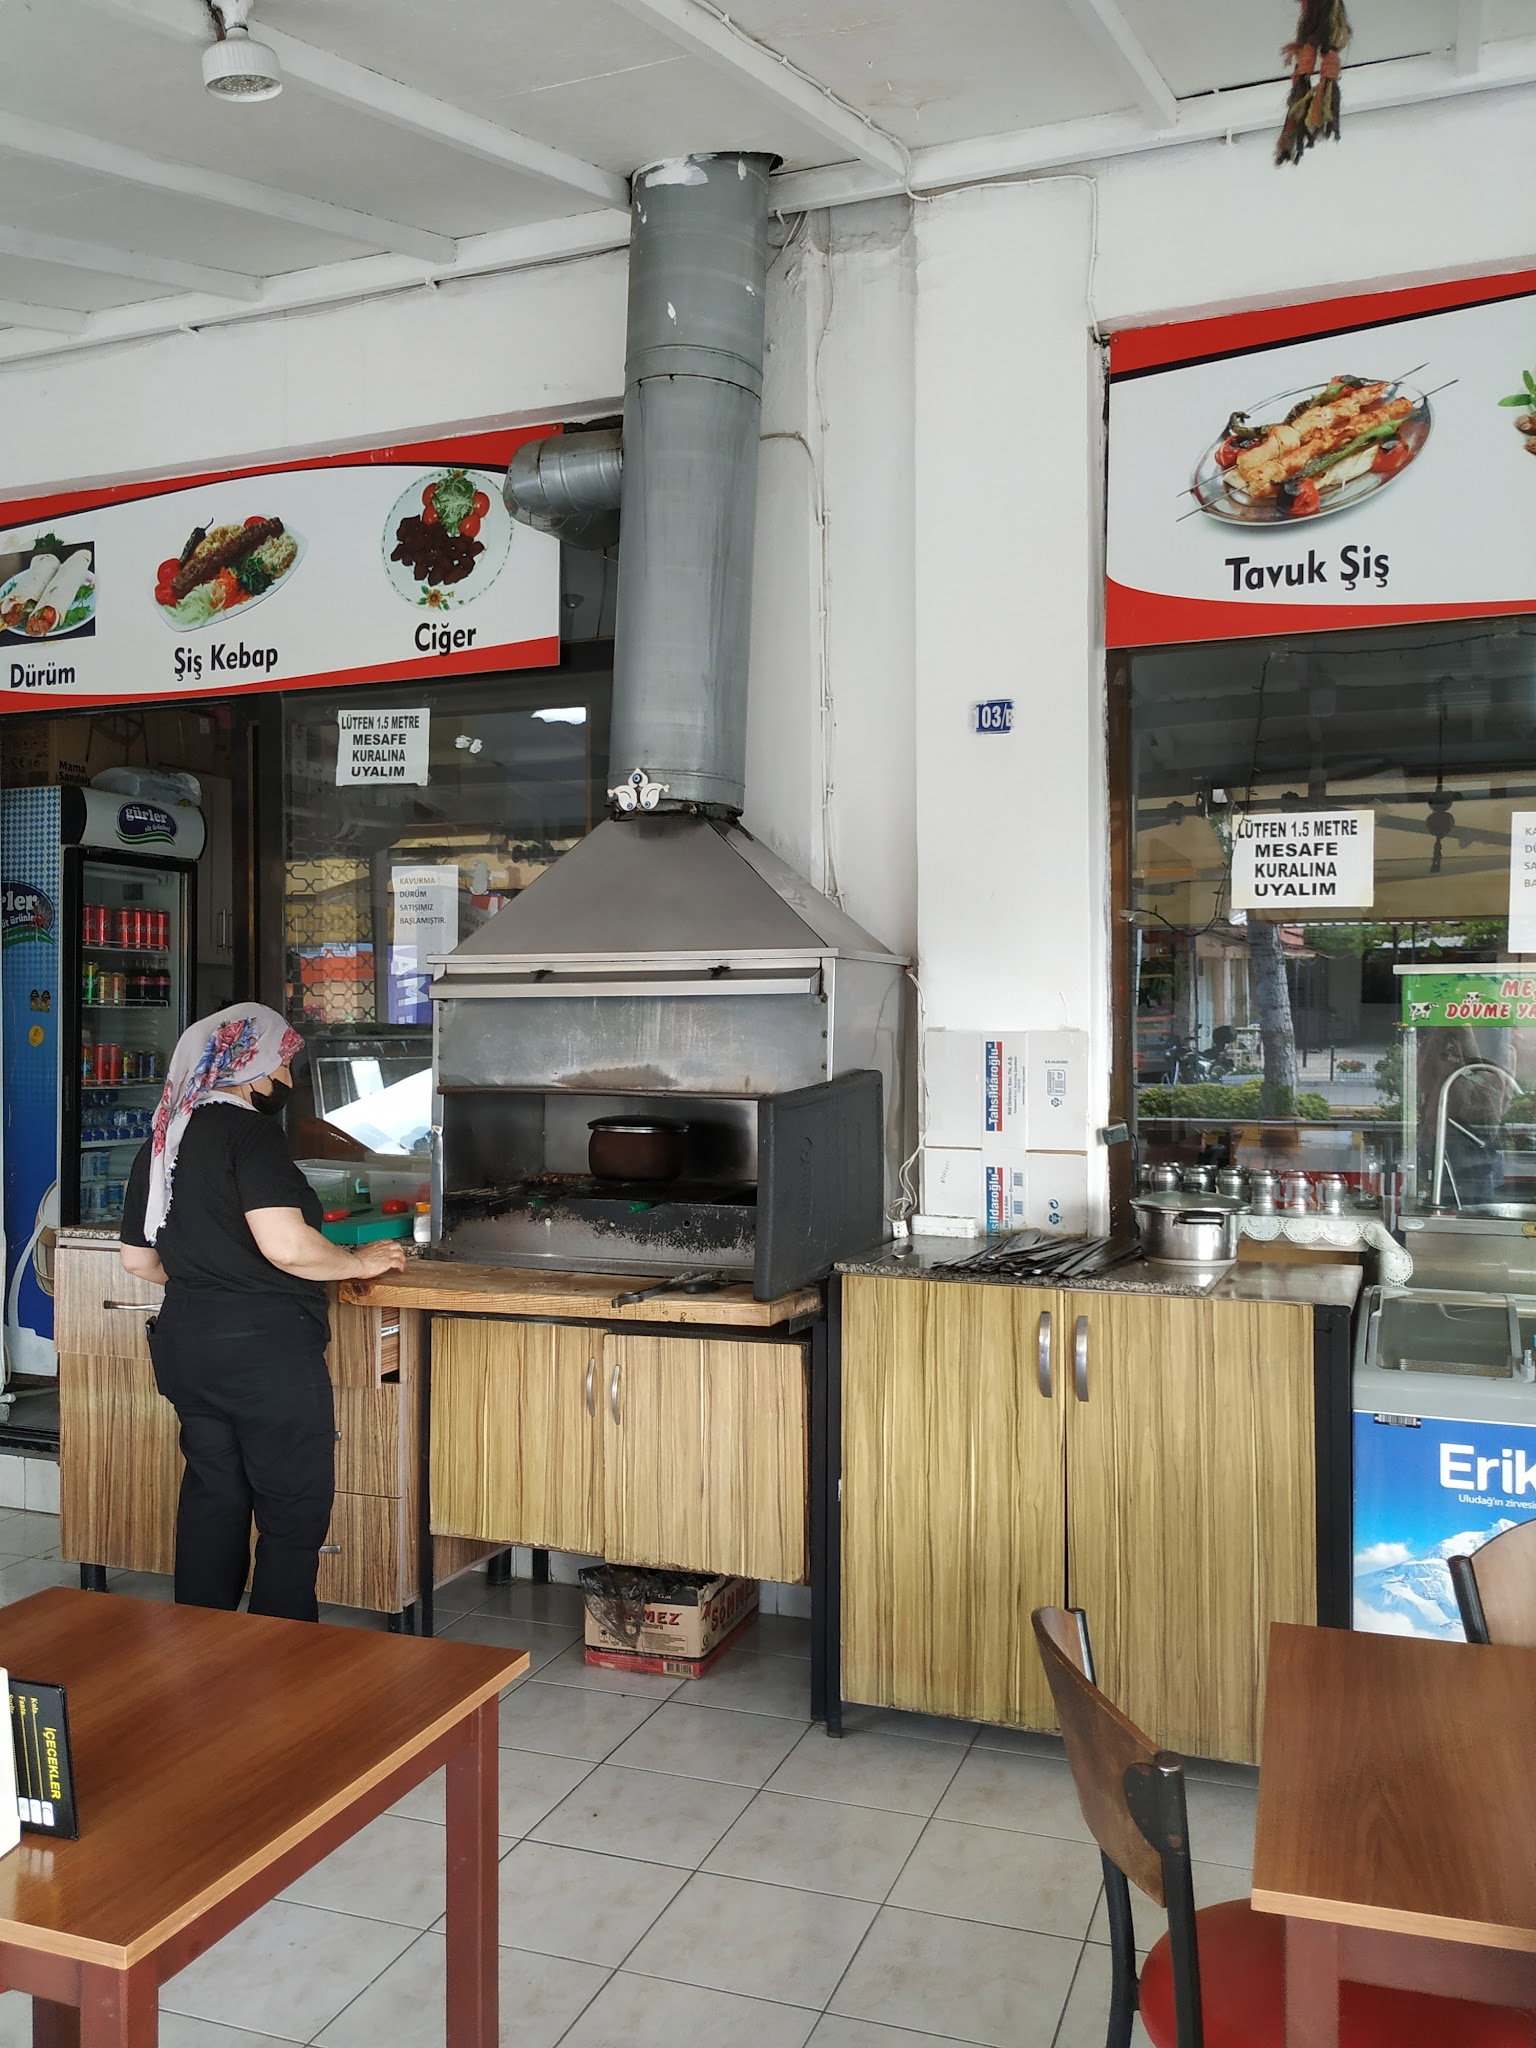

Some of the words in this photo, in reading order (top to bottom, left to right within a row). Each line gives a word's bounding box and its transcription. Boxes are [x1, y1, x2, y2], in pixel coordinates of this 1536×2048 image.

[1225, 549, 1327, 591] Tavuk
[1340, 545, 1390, 591] Şiş
[414, 622, 477, 656] Ciğer
[173, 647, 203, 681] Şiş
[210, 643, 279, 674] Kebap
[10, 663, 76, 688] Dürüm
[341, 714, 375, 730] LÜTFEN
[376, 715, 389, 730] 1.5
[391, 715, 420, 729] METRE
[352, 733, 407, 746] MESAFE
[352, 749, 406, 762] KURALINA
[351, 766, 405, 777] UYALIM
[125, 806, 168, 824] gürler
[1291, 821, 1310, 838] 1.5
[1313, 819, 1358, 836] METRE
[1255, 842, 1338, 858] MESAFE
[1254, 862, 1338, 878] KURALINA
[399, 877, 436, 885] KAVURMA
[1254, 882, 1337, 896] UYALIM
[399, 890, 427, 898] DÜRÜM
[399, 903, 434, 913] SATIŞIMIZ
[1501, 979, 1536, 999] ME
[1446, 999, 1510, 1019] DÖVME
[988, 1048, 1001, 1125] Tahsildaroğlu
[1458, 1493, 1504, 1508] Uludağ'ın
